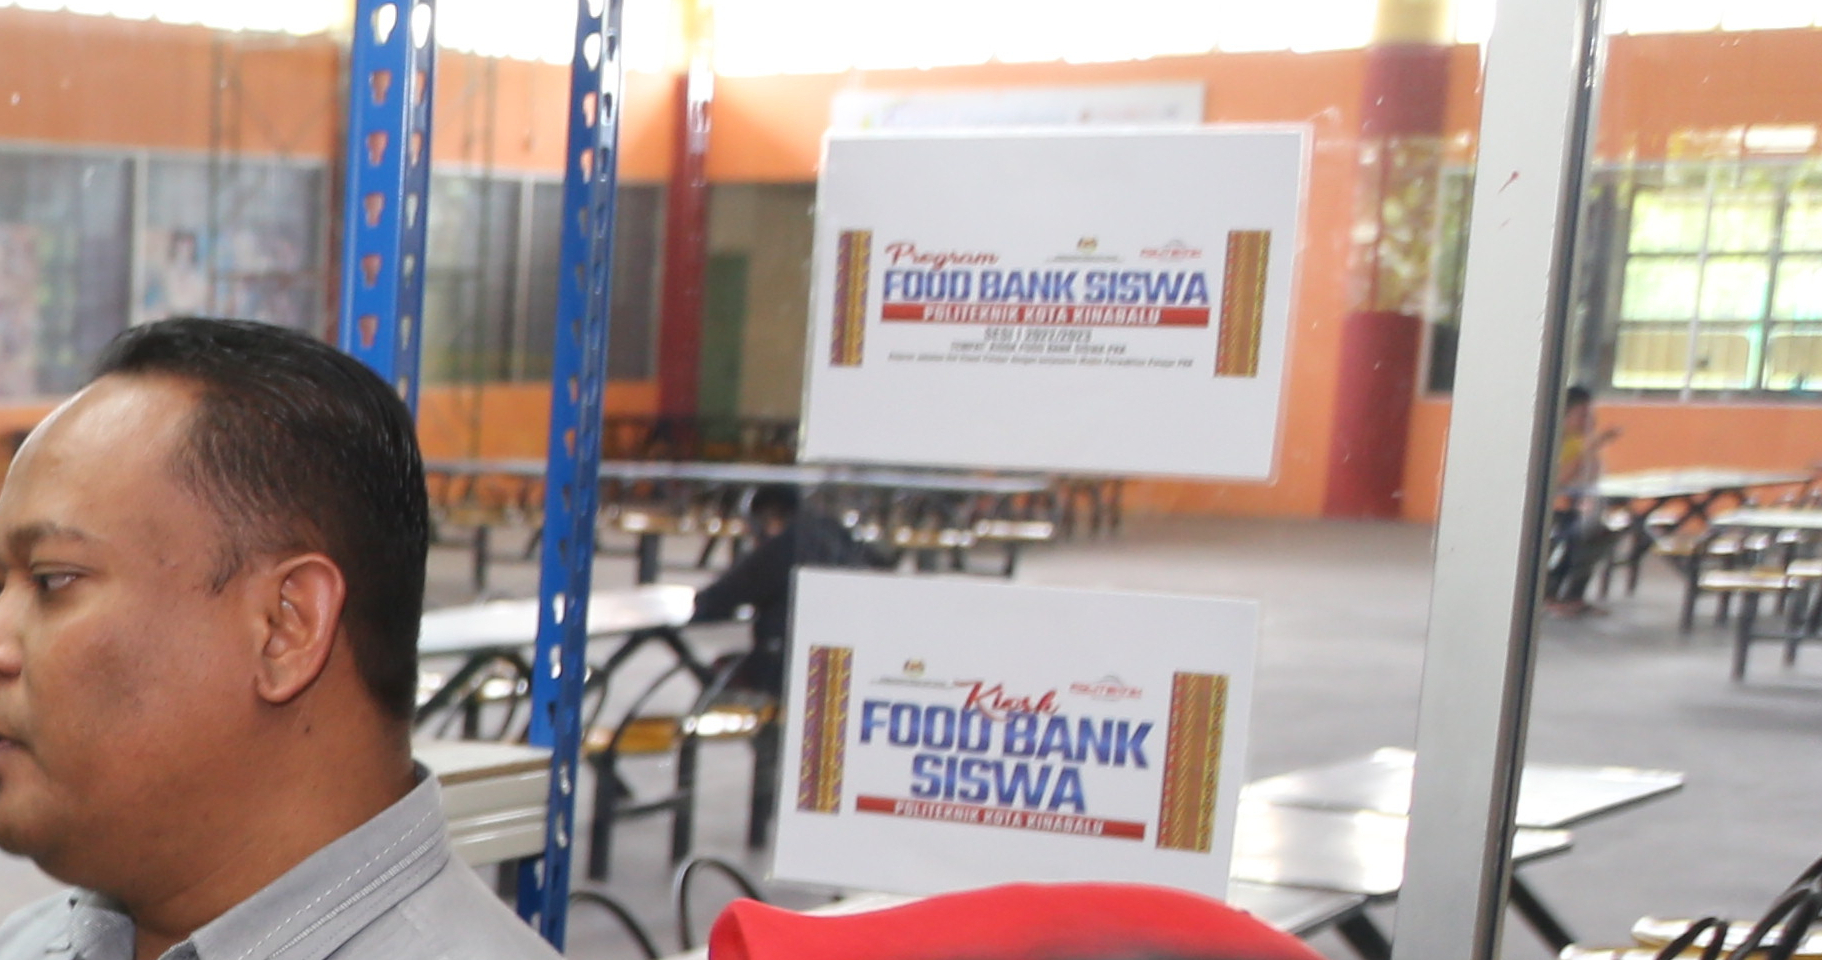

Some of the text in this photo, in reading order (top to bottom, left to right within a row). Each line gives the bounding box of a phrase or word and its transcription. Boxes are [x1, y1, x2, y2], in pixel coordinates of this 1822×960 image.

[884, 242, 999, 270] Program
[883, 269, 1209, 306] FOOD BANK SISWA
[923, 304, 1162, 326] POLITEKNIK KOTA KINABALU
[953, 680, 1060, 722] Kiosk
[860, 699, 1154, 769] FOOD BANK
[910, 753, 1086, 815] SISWA
[894, 801, 1104, 836] POLITEKNIK KOTA KINABALU
